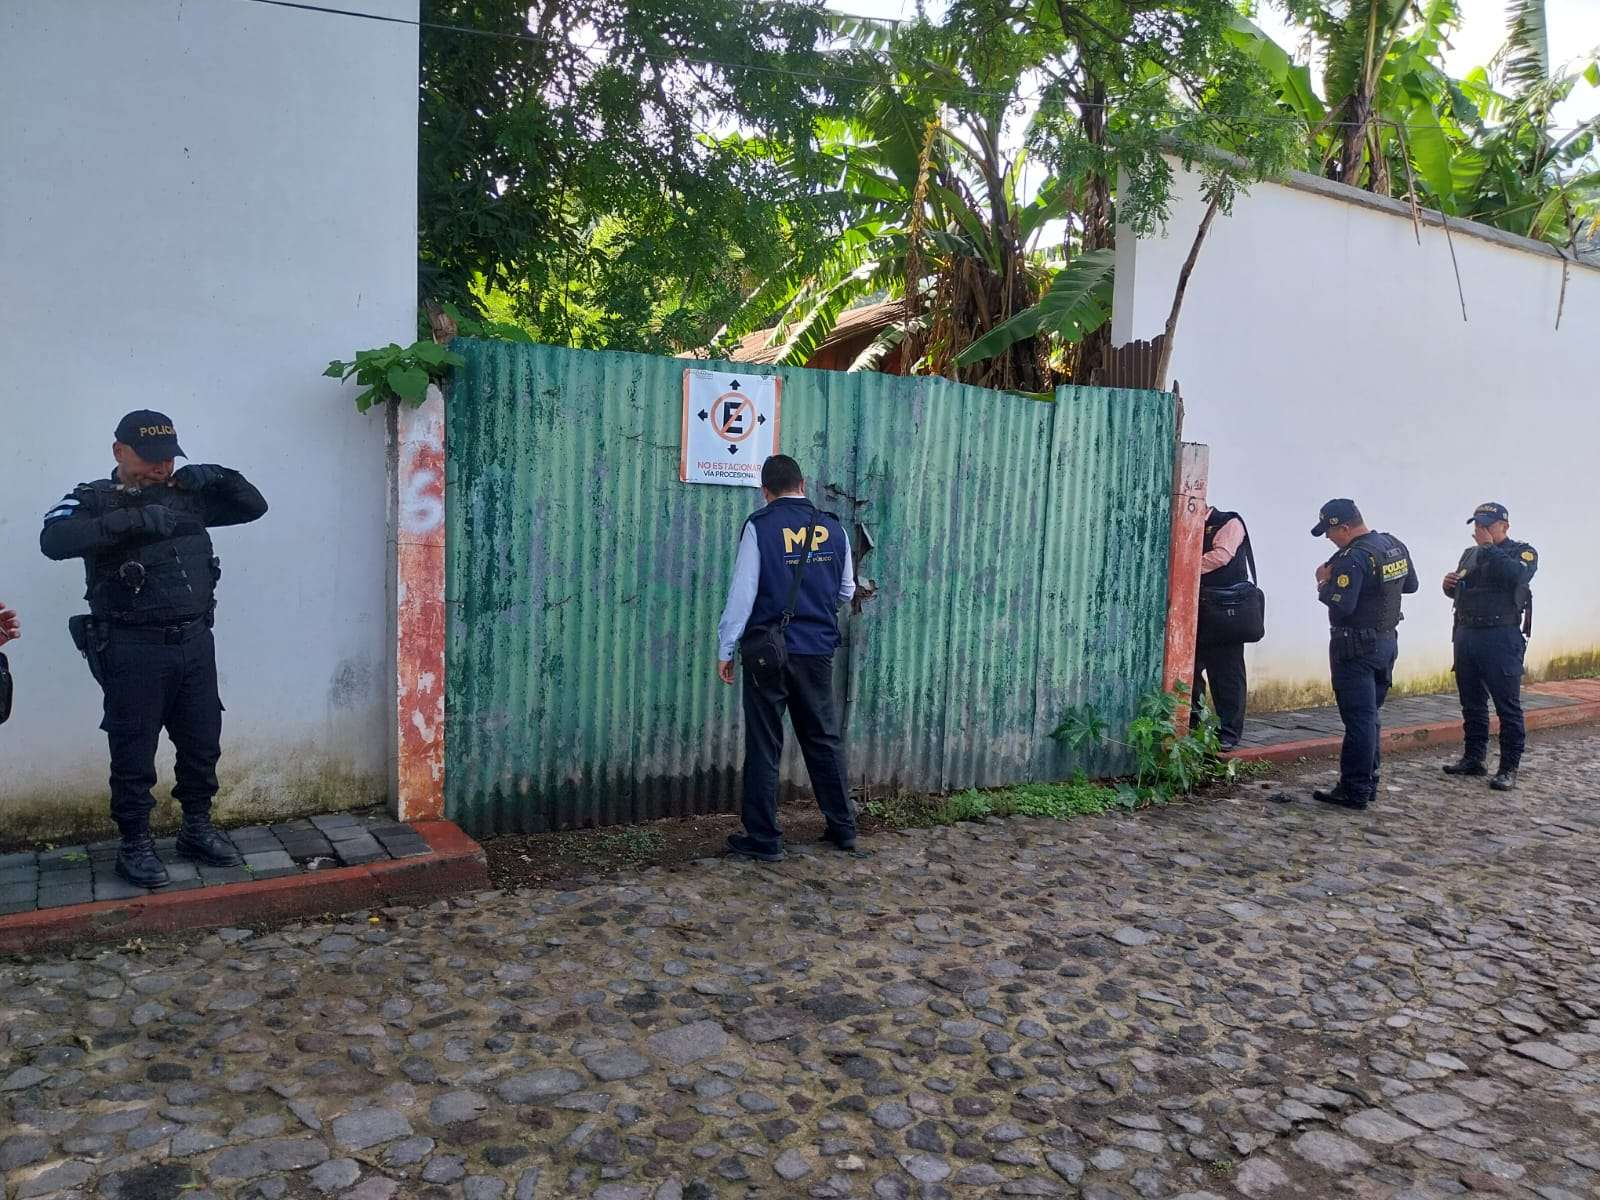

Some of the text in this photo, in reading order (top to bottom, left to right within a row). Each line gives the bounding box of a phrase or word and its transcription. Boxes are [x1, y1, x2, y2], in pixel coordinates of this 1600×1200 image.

[697, 461, 762, 472] NO ESTACIONAR
[1187, 495, 1196, 513] 6
[782, 525, 829, 553] MP
